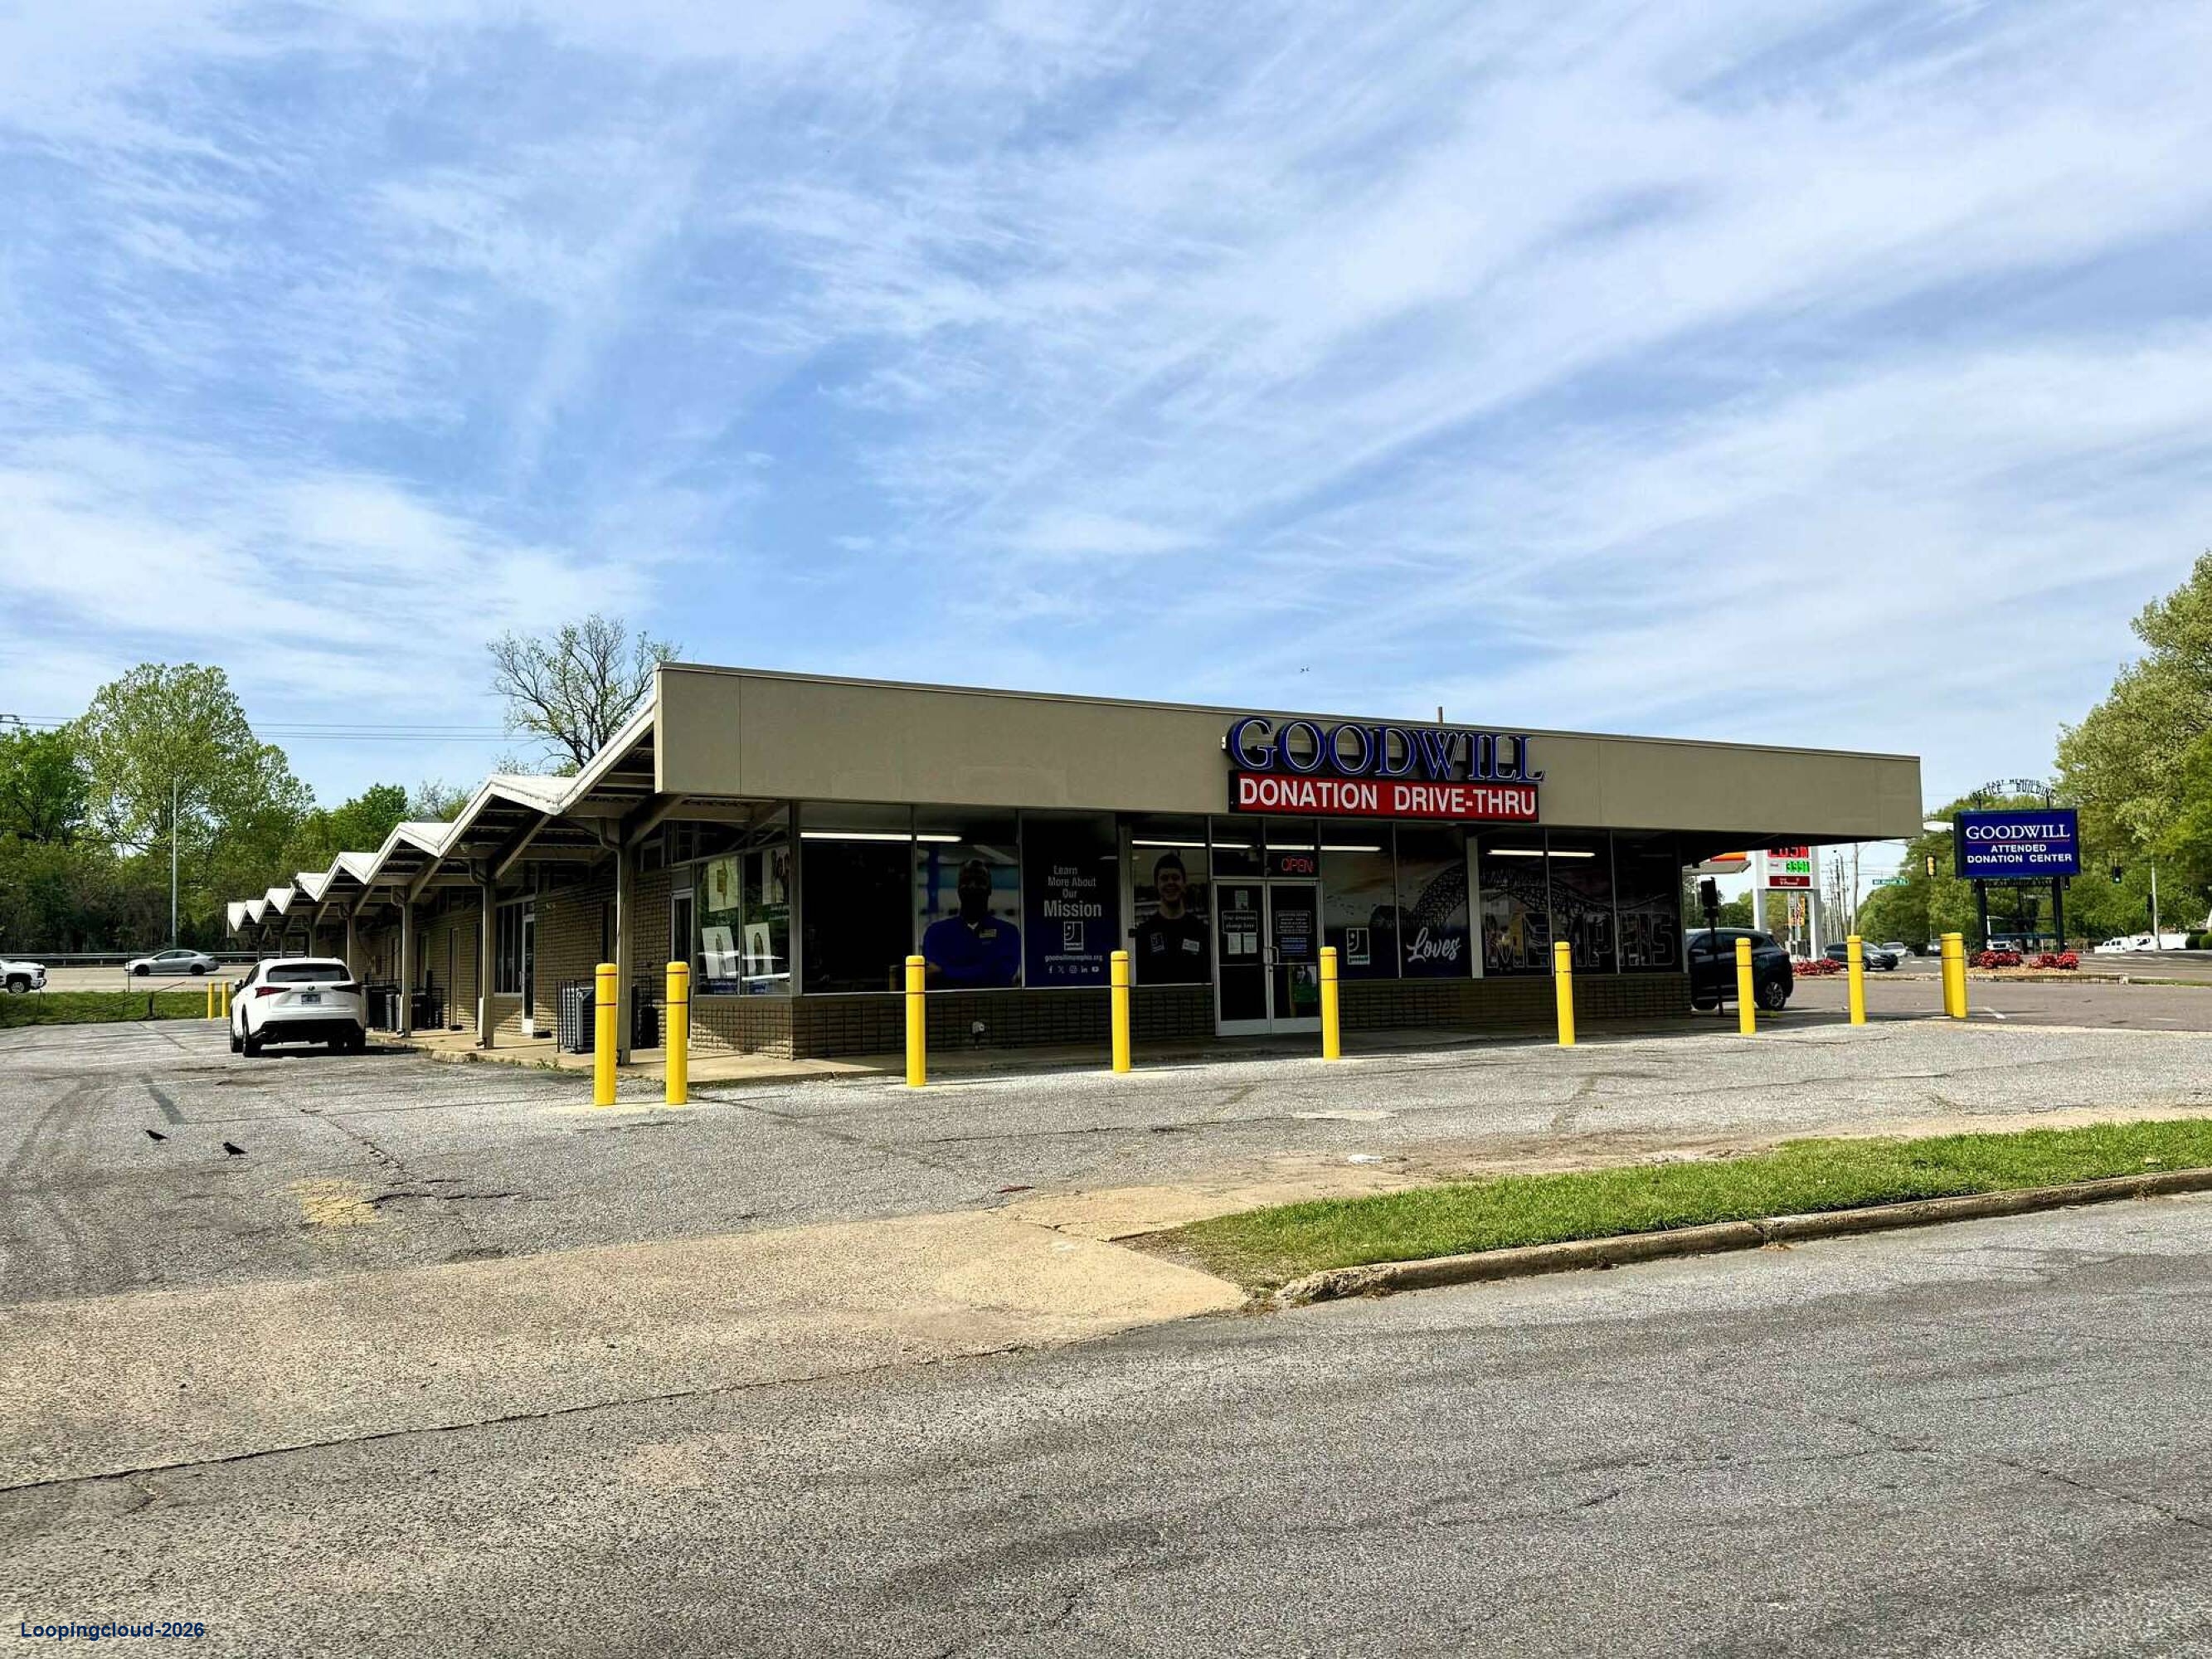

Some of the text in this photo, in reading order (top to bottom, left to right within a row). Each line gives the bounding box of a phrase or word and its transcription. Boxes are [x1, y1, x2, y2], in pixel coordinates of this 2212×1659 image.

[1228, 717, 1544, 783] GOODWILL
[1239, 778, 1536, 815] DONATION DRIVE-THRU
[1966, 824, 2070, 839] GOODWILL
[1991, 844, 2047, 853] ATTENDED
[1281, 856, 1314, 873] OPEN
[1966, 854, 2073, 864] DONATION CENTER
[1053, 865, 1078, 874] Learn
[1048, 876, 1096, 887] More About
[1062, 888, 1077, 898] Our
[1043, 900, 1102, 917] Mission
[1407, 927, 1461, 962] Loves
